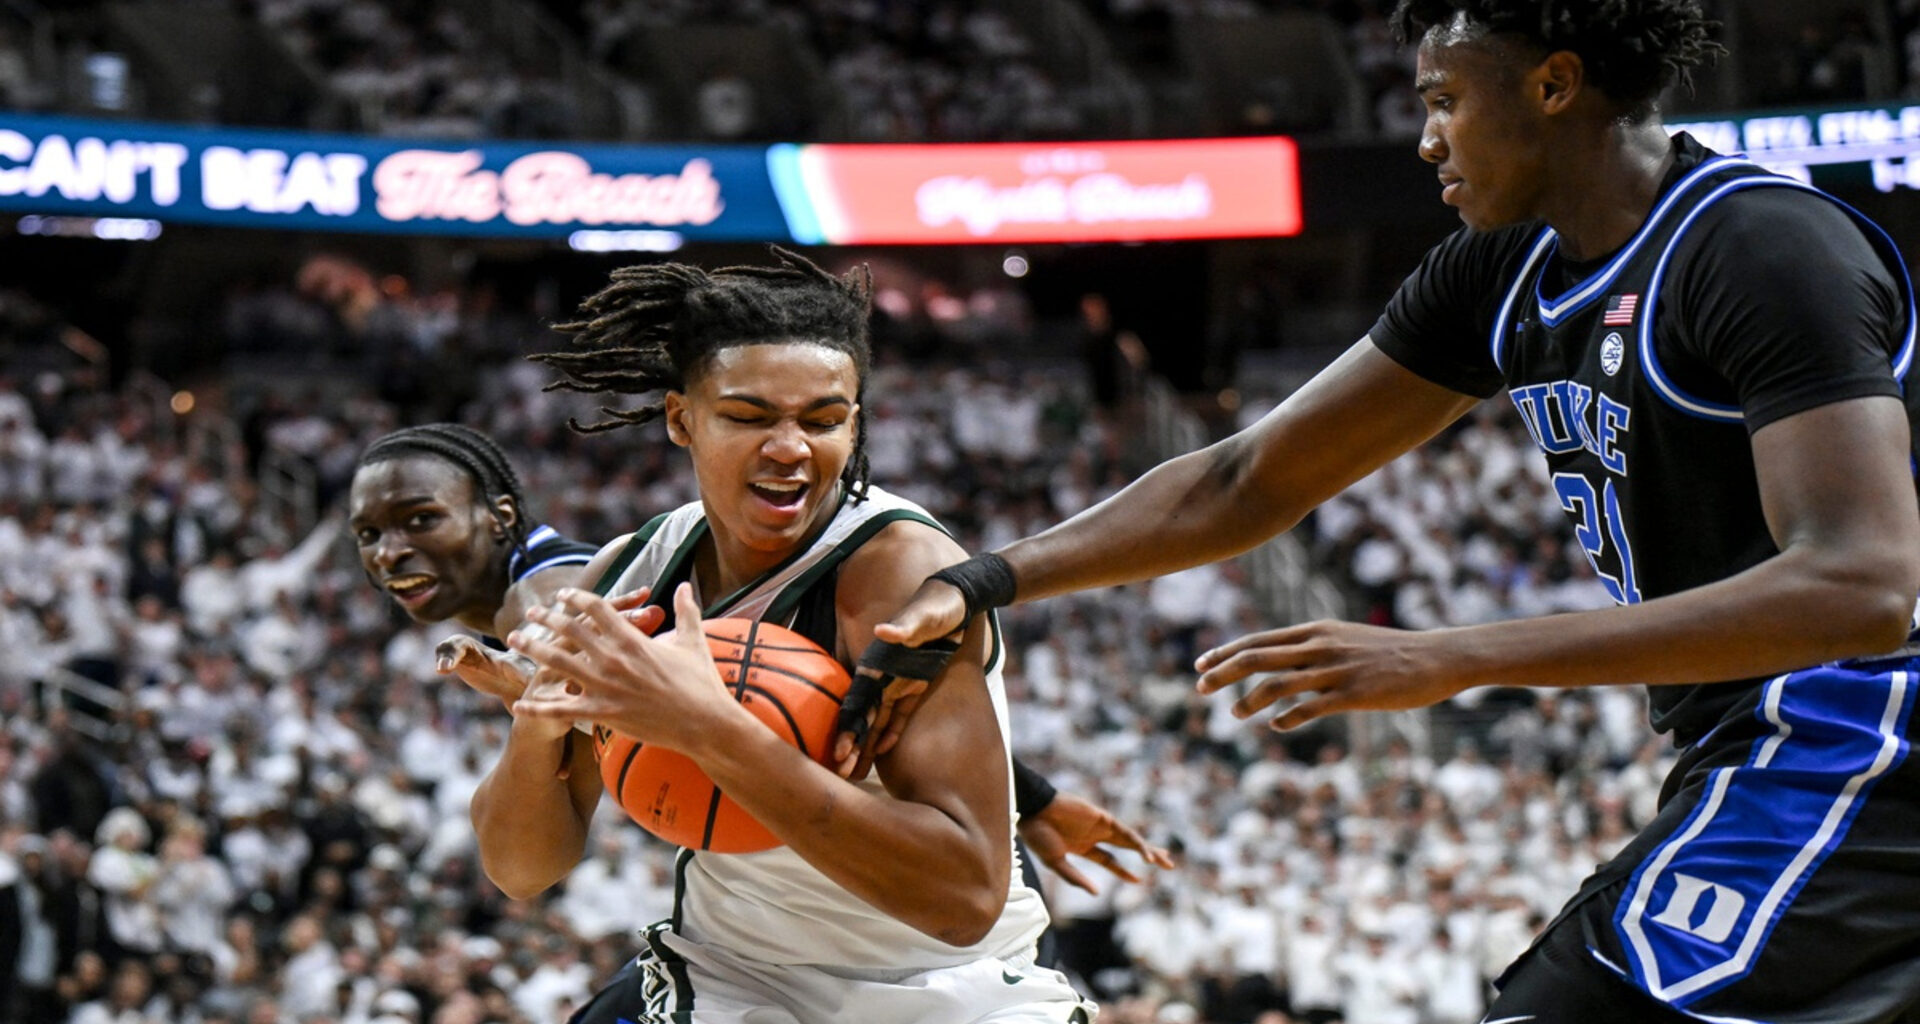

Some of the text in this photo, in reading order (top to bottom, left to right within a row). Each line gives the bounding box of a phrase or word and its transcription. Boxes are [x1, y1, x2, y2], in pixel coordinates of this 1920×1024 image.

[0, 130, 187, 206] CAN'T
[201, 146, 366, 215] BEAT
[374, 151, 500, 220] The
[1551, 471, 1642, 606] 21
[1650, 871, 1745, 943] D
